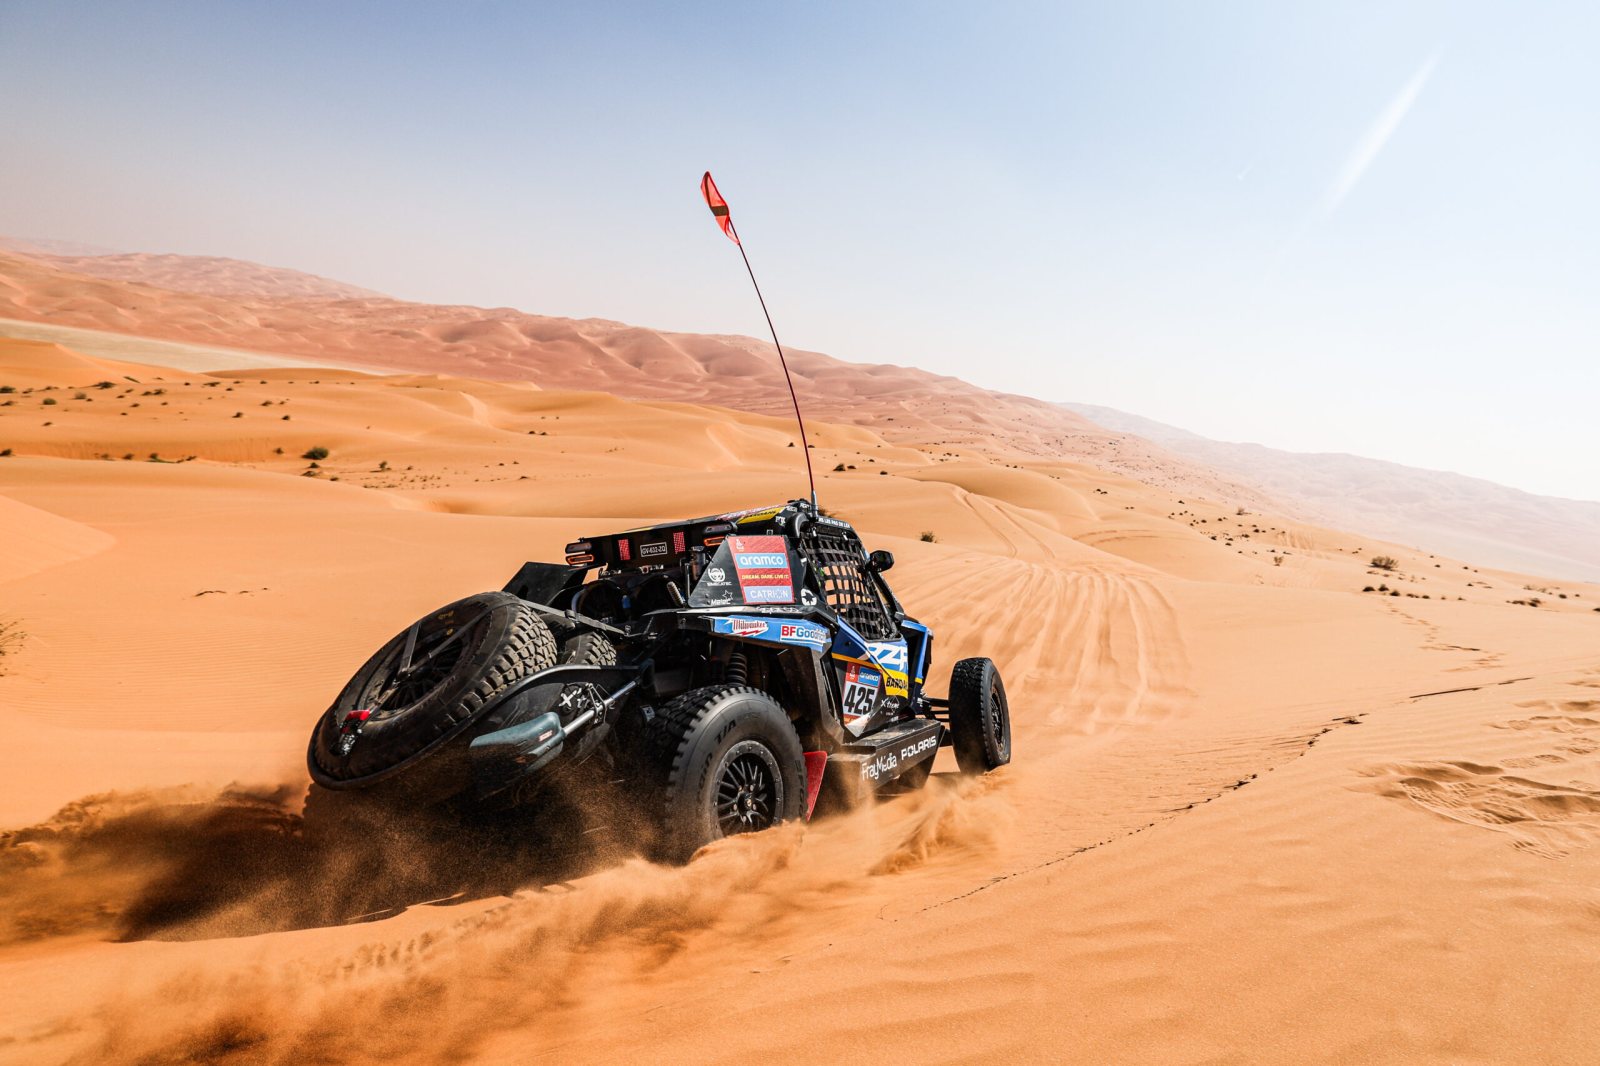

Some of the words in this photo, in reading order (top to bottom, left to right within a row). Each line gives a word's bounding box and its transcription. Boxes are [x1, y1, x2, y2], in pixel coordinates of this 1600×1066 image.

[740, 556, 784, 565] aramco
[750, 589, 789, 599] CATRION
[733, 619, 766, 630] Milwaukee
[844, 685, 875, 715] 425
[900, 735, 937, 761] POLARIS
